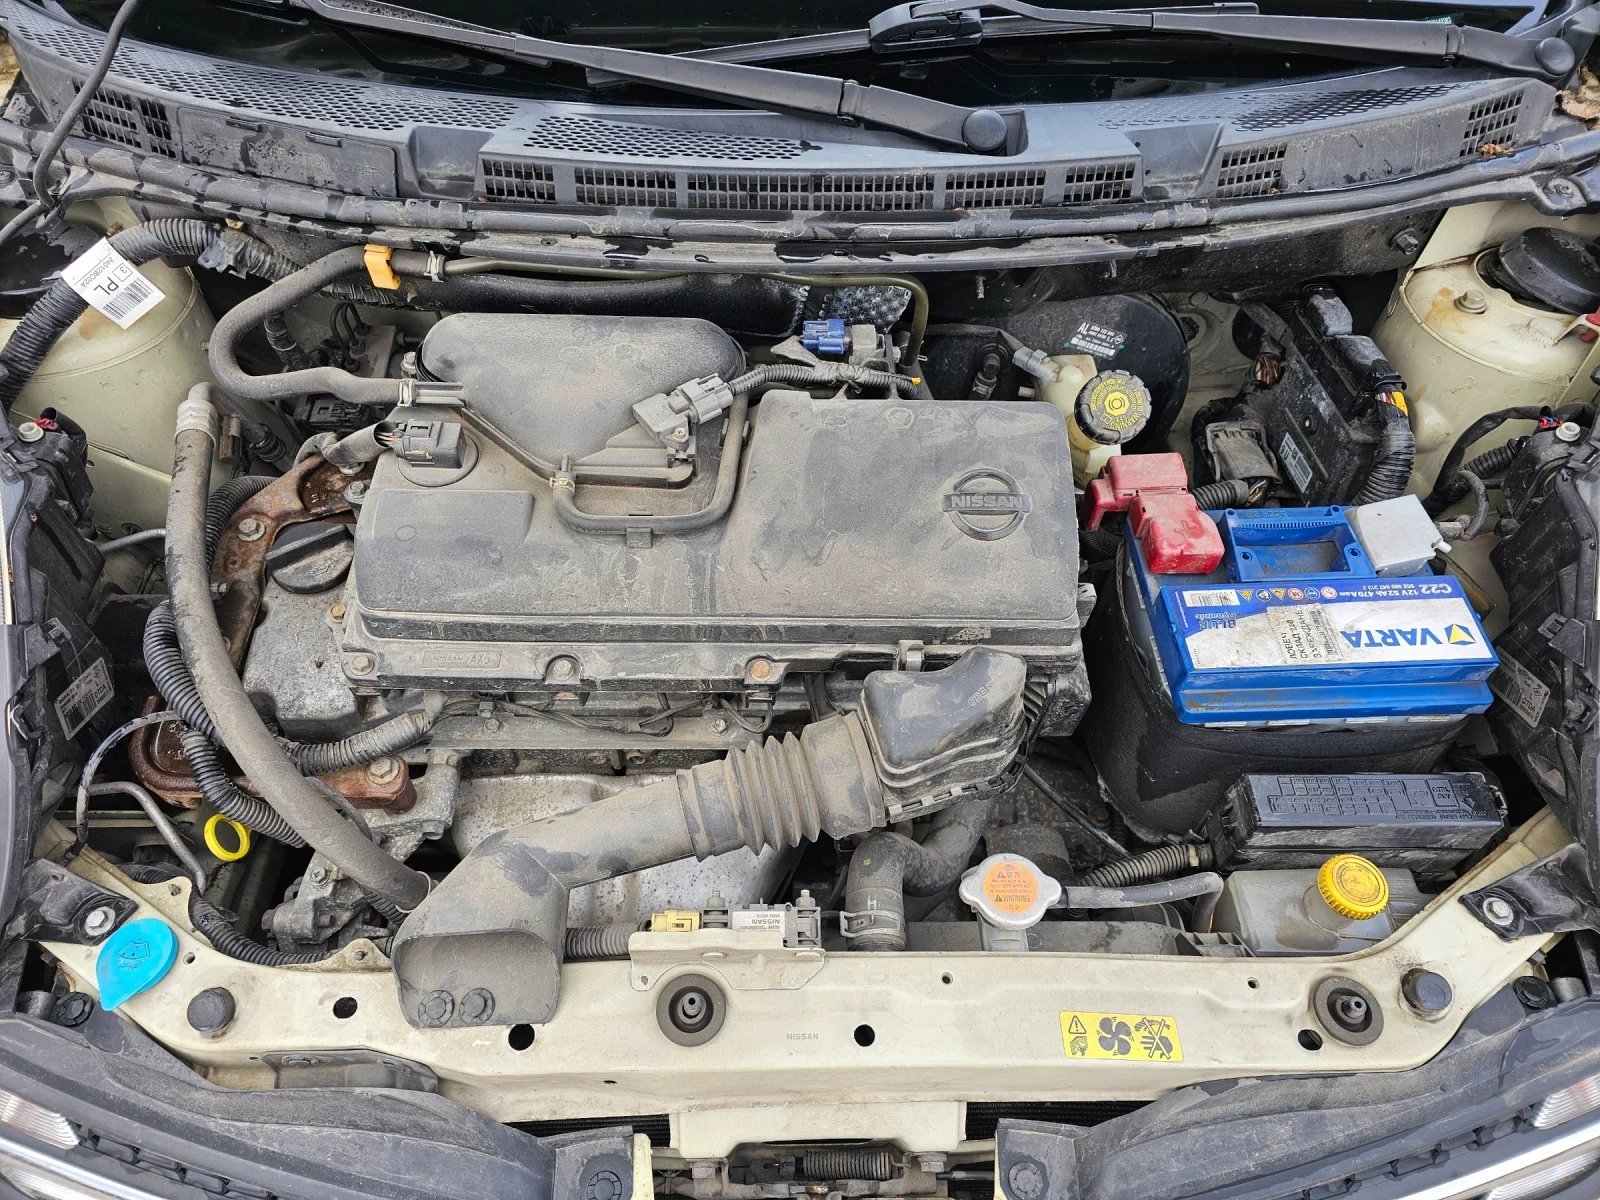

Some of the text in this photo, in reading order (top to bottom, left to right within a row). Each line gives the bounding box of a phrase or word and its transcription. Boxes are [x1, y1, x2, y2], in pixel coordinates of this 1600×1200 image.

[79, 256, 115, 288] 24012BC02A
[119, 265, 127, 275] 3
[93, 276, 119, 296] PL
[1077, 322, 1090, 335] AL
[951, 496, 1023, 508] NISSAN
[1418, 583, 1452, 594] C22
[1195, 612, 1236, 620] Dynamic
[1199, 620, 1236, 629] BLUE
[1340, 627, 1442, 648] VARTA
[1280, 632, 1298, 659] ЛОВЕЧ
[1292, 633, 1308, 659] СКЛАД
